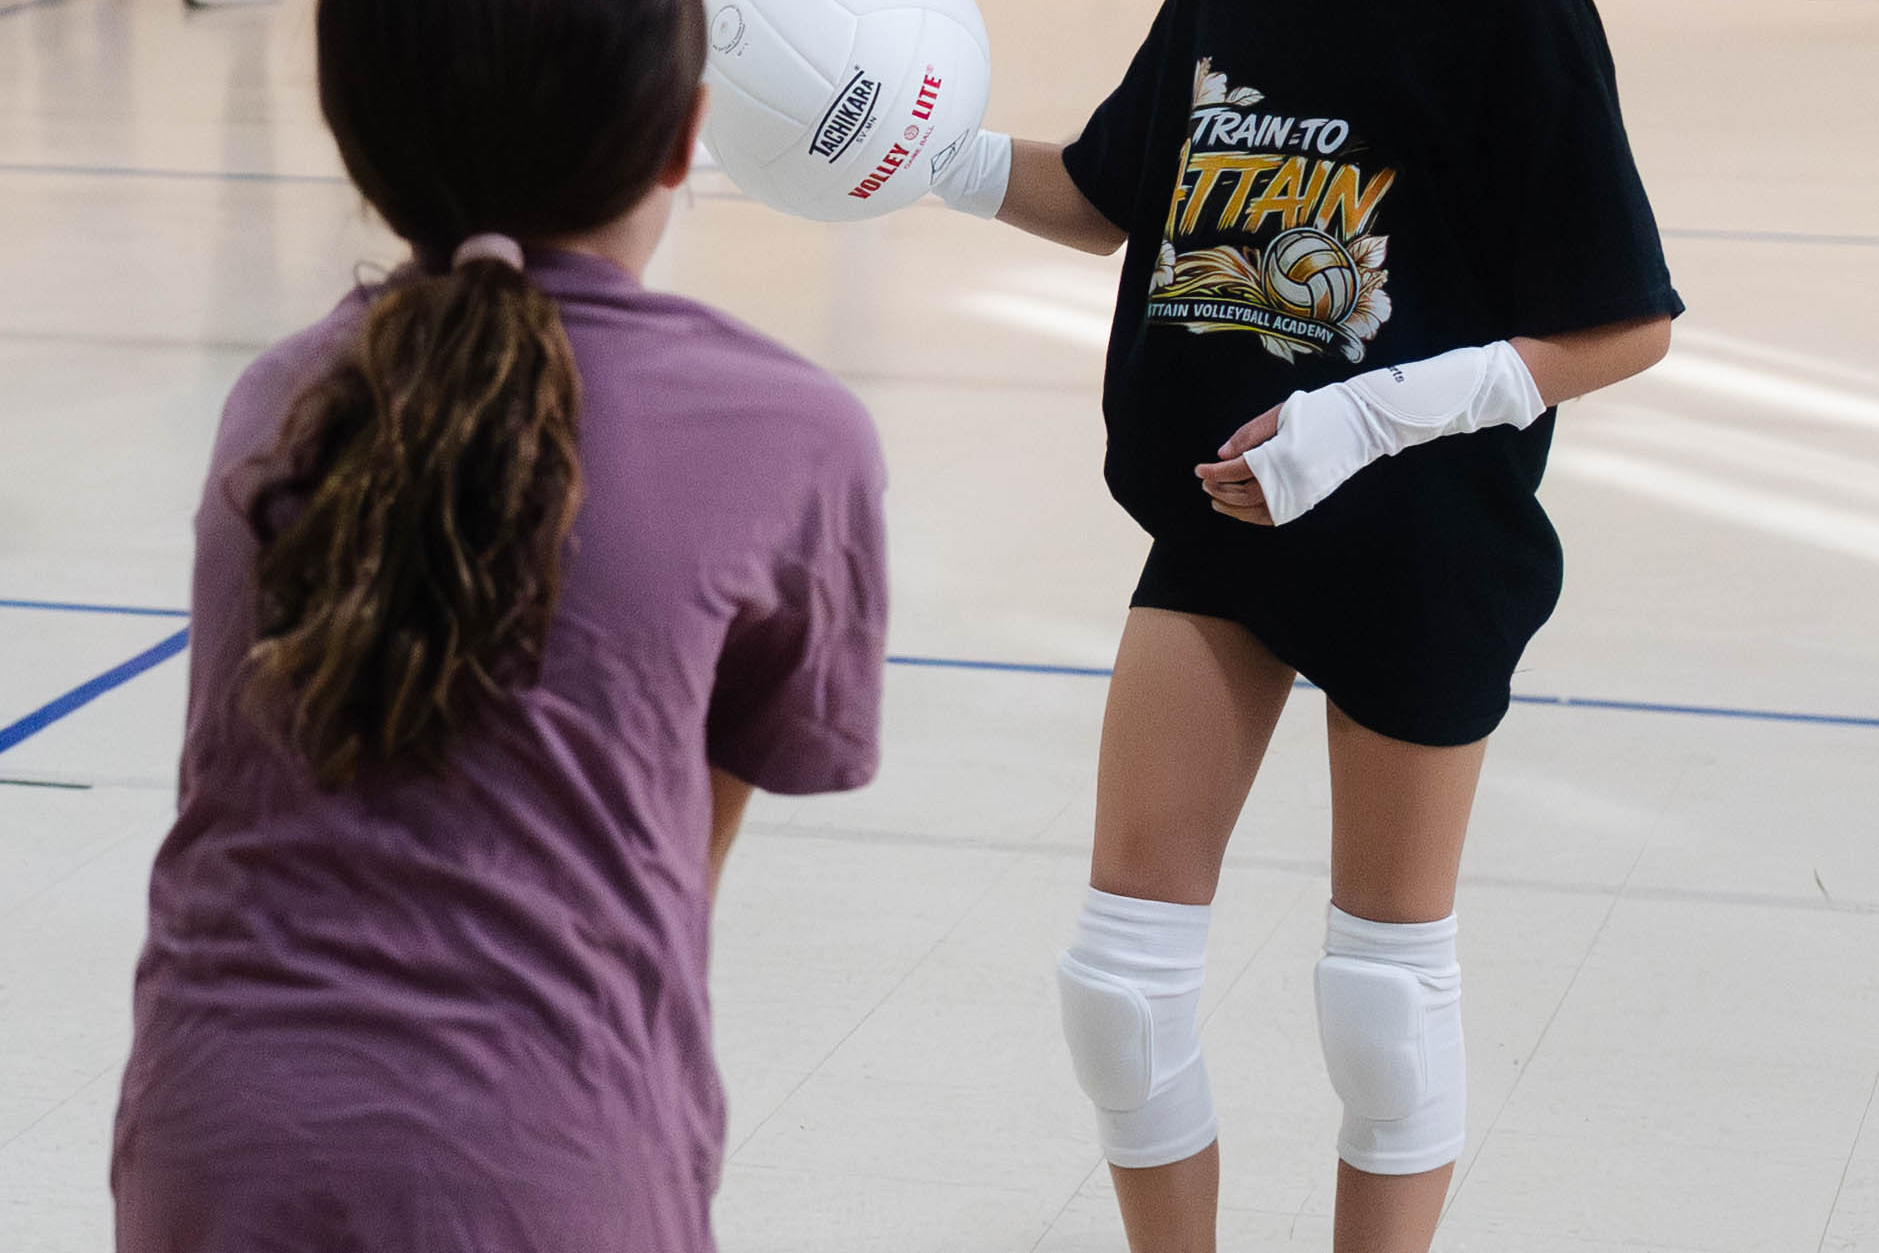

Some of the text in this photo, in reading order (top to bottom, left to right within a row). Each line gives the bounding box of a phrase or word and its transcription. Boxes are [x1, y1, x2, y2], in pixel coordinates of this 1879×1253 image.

[809, 78, 876, 158] TACHIKARA
[848, 74, 943, 200] VOLLEY LITE
[1193, 303, 1270, 327] VOLLEYBALL
[1272, 315, 1335, 344] ACADEMY
